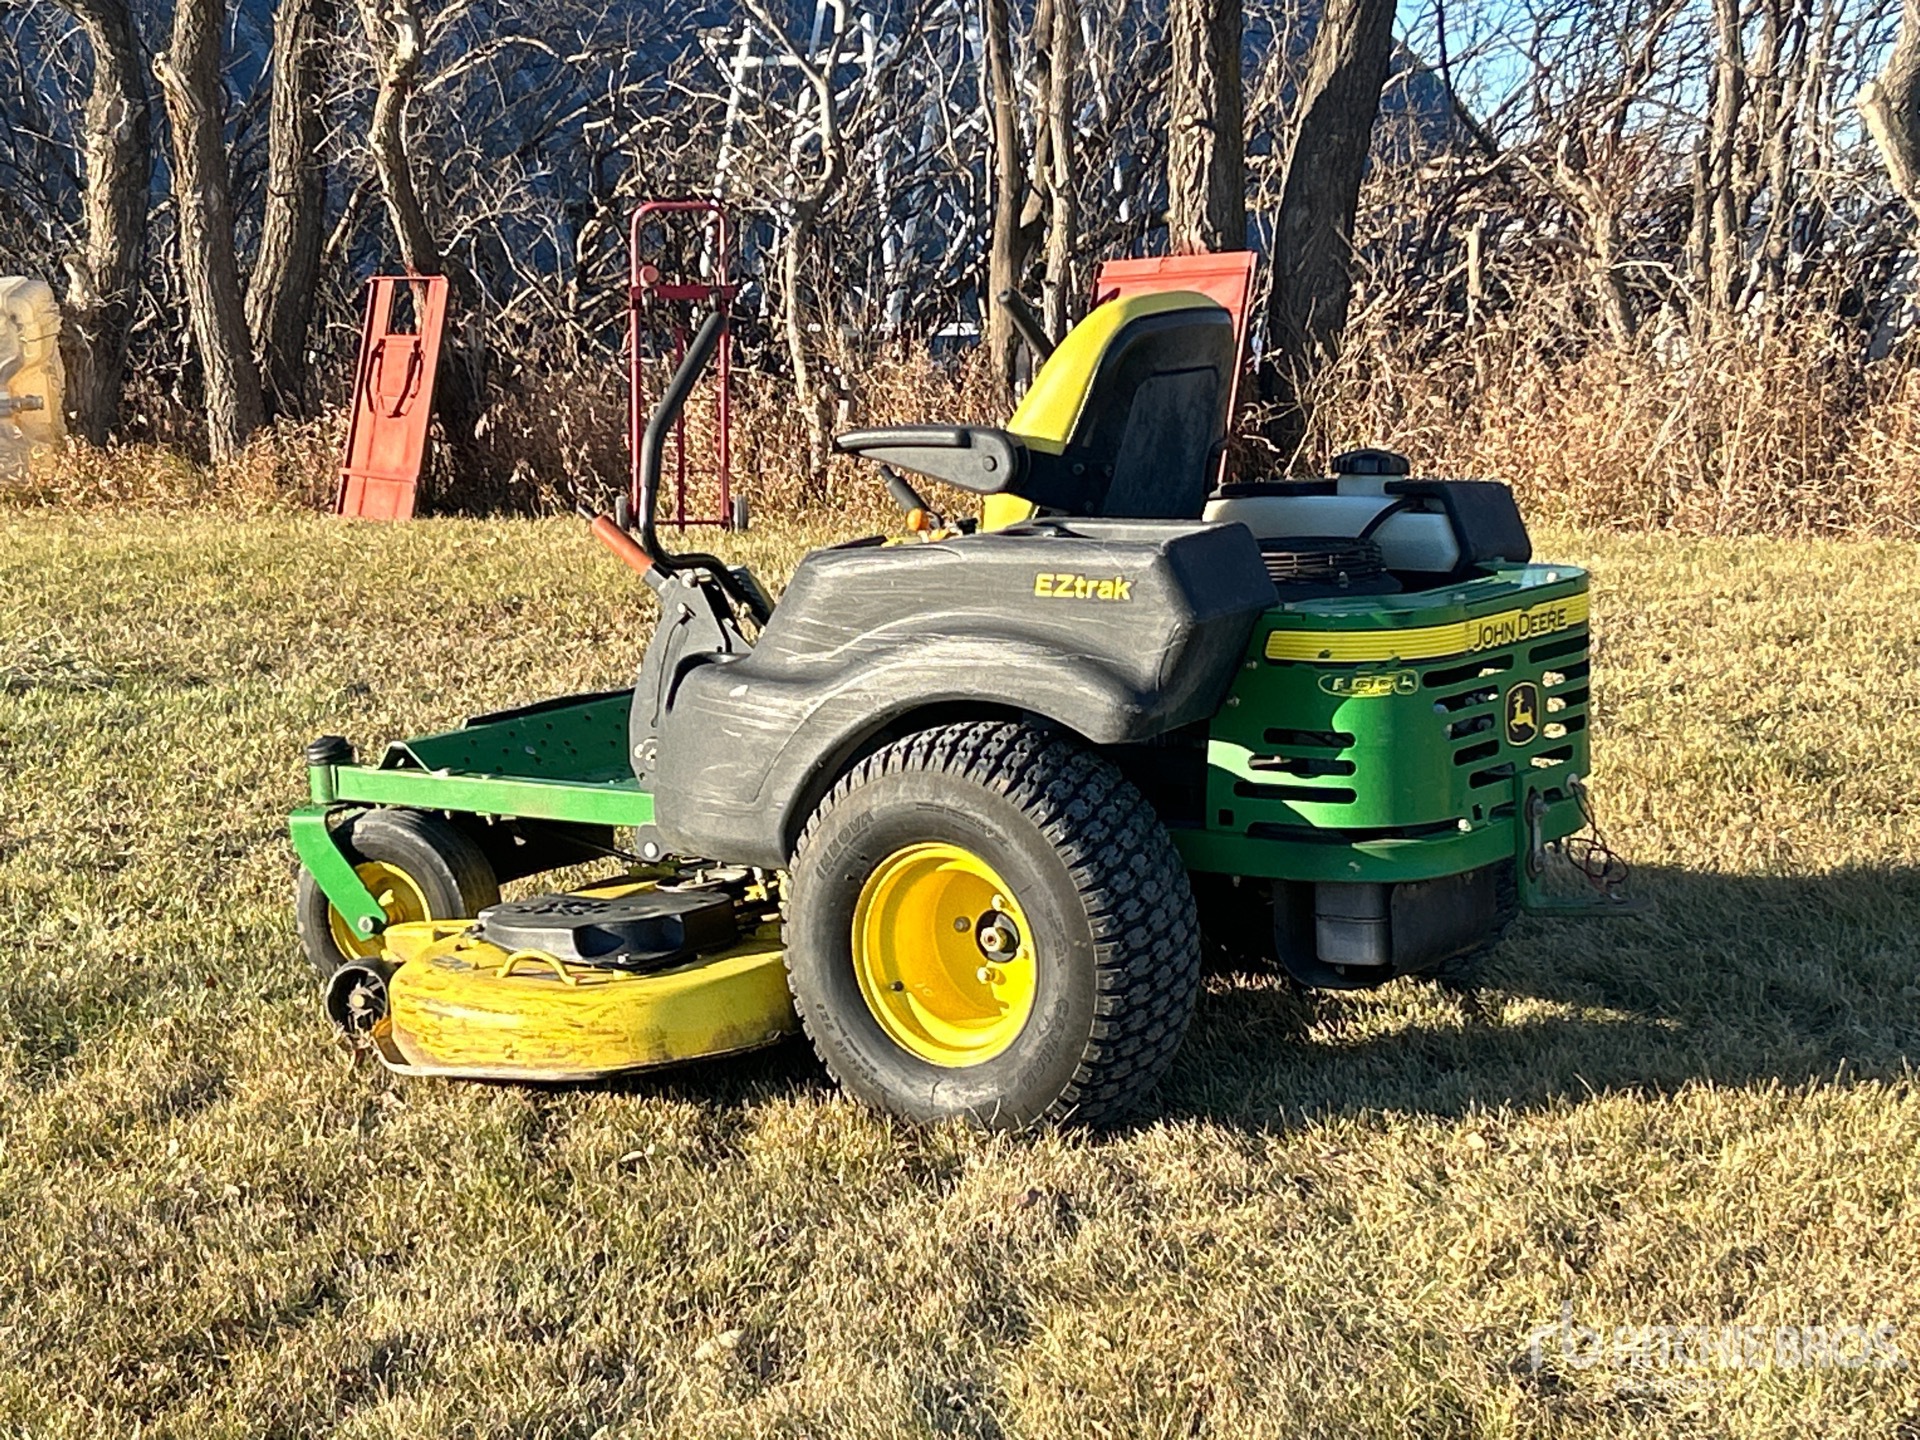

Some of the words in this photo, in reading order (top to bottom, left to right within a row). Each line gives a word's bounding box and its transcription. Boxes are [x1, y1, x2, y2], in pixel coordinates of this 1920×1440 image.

[1034, 573, 1132, 600] EZtrak
[1473, 619, 1515, 649] JOHN
[1518, 607, 1567, 637] DEERE
[814, 809, 875, 881] INNOVA
